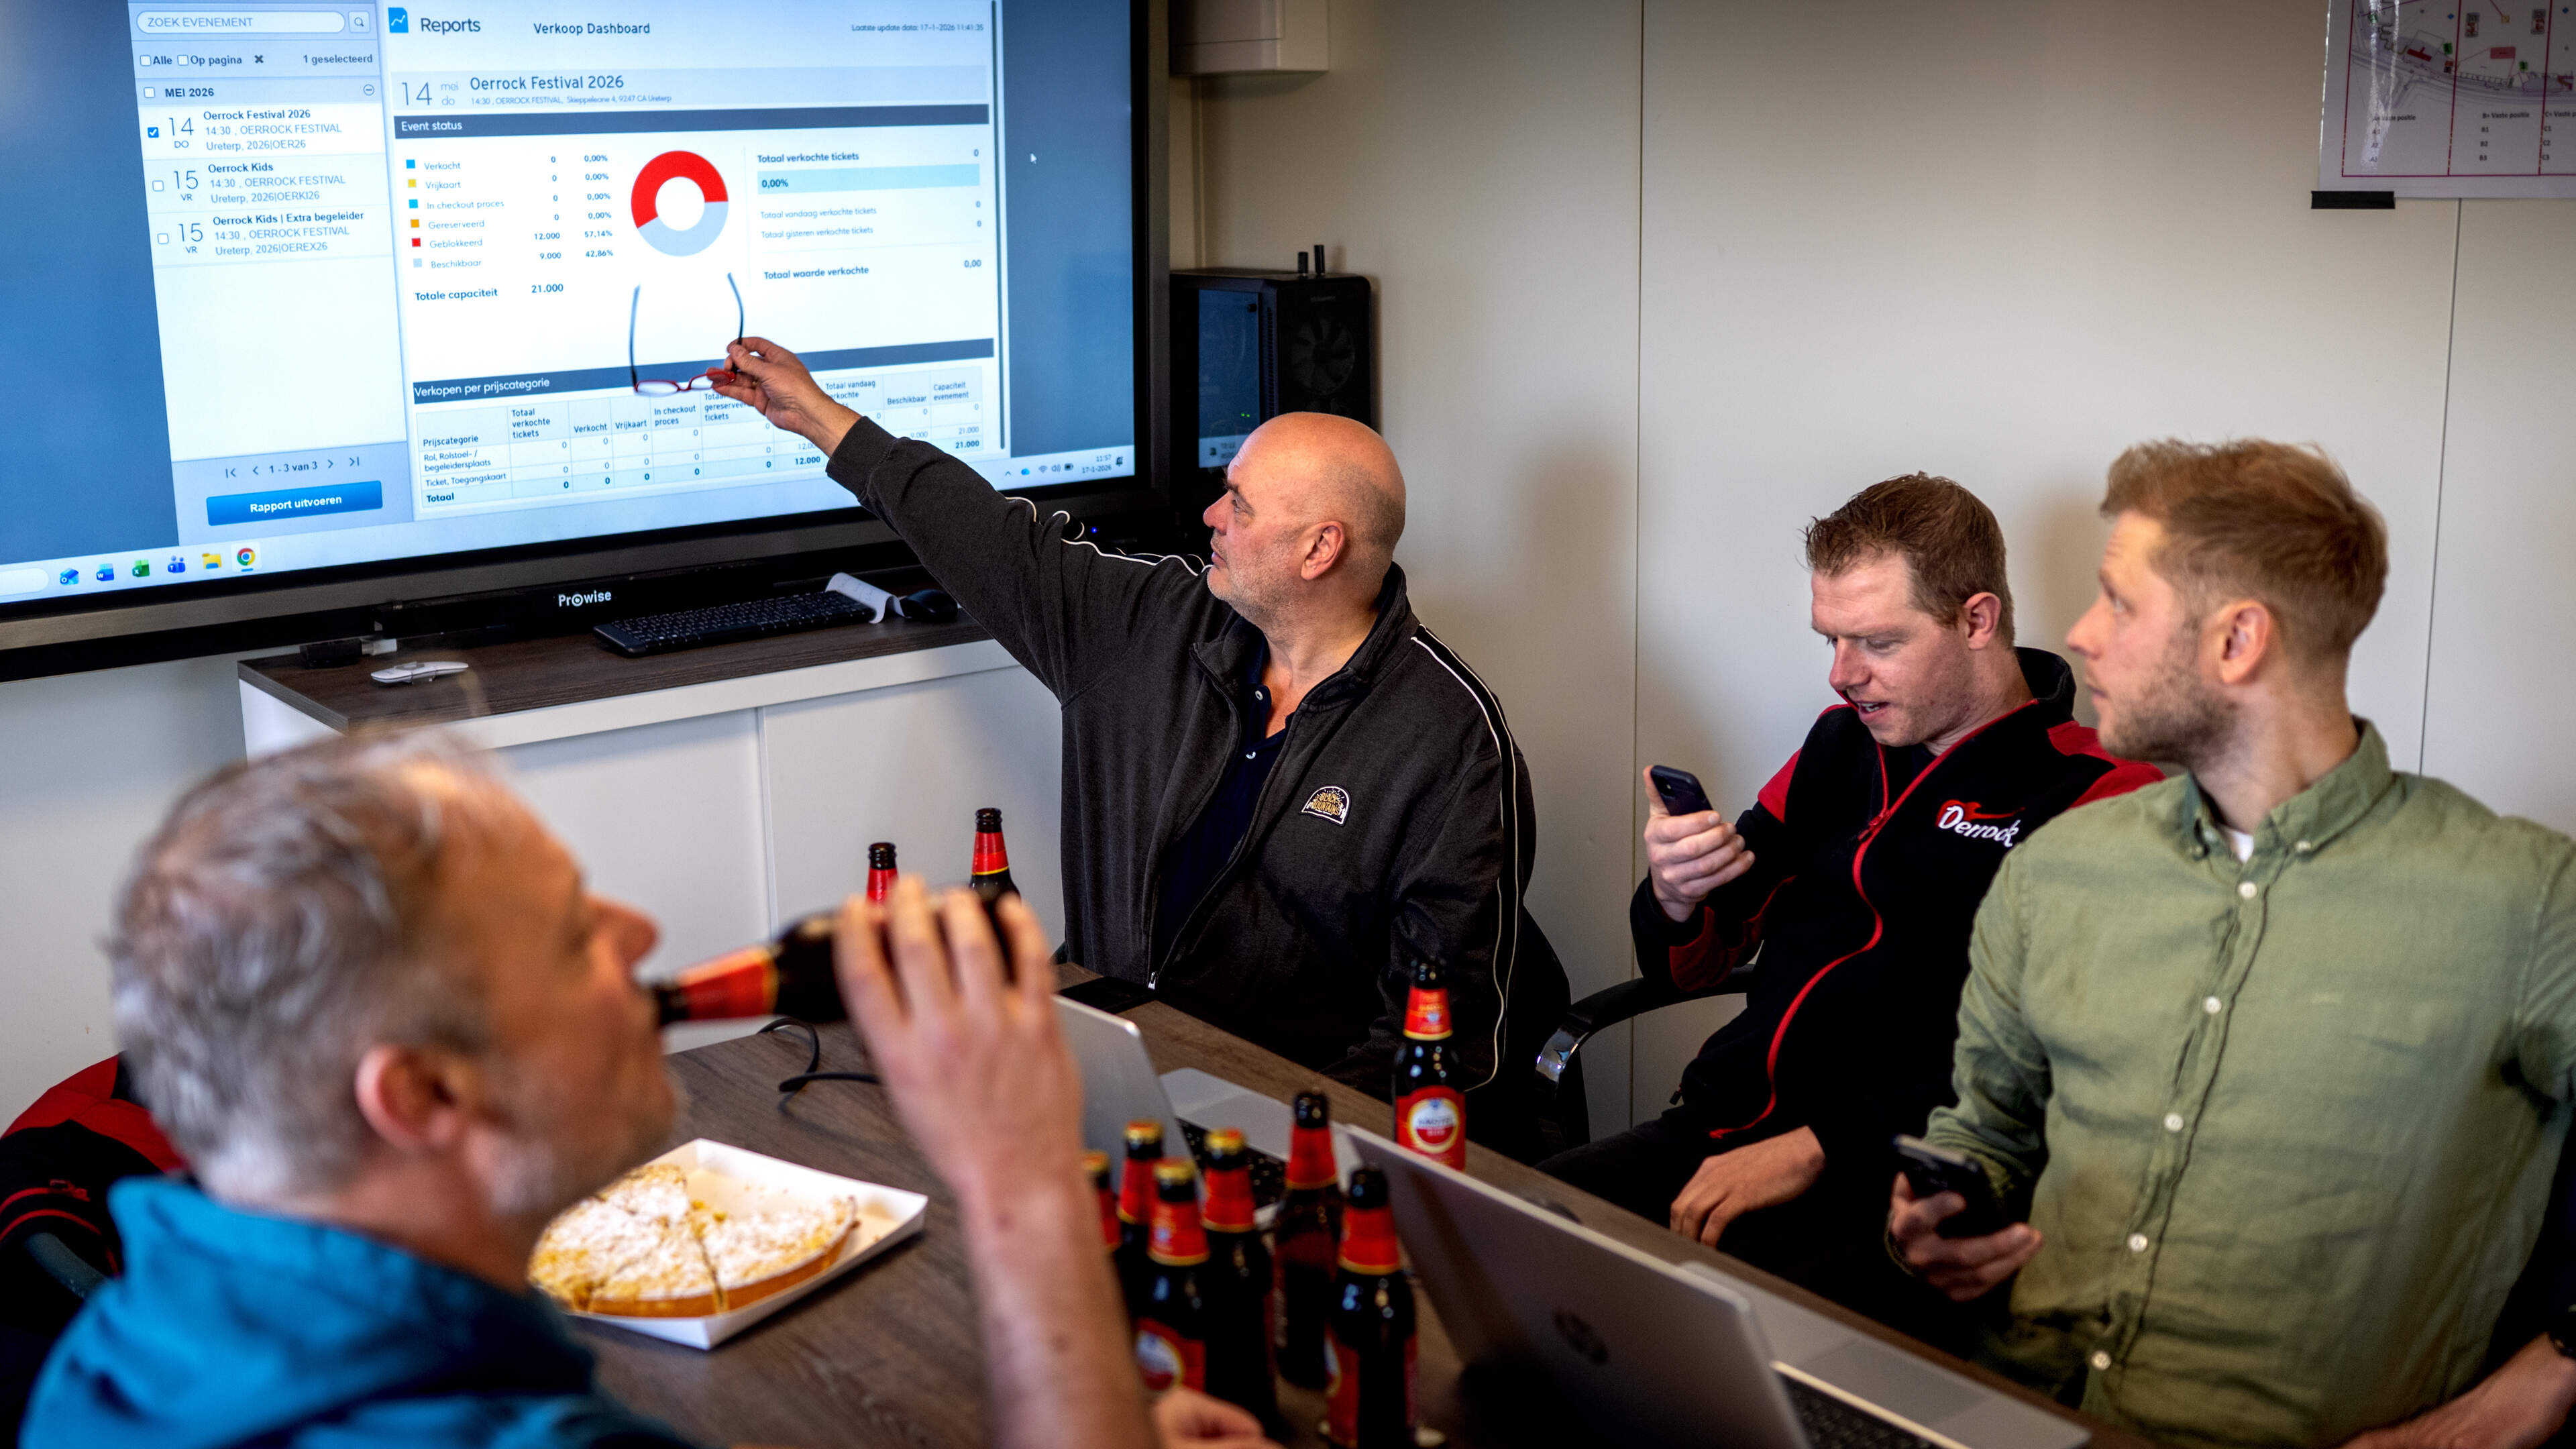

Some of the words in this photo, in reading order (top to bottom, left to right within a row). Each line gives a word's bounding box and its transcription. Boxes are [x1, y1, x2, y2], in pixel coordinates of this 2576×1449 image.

[148, 17, 179, 27] ZOEK
[183, 17, 254, 27] EVENEMENT
[421, 18, 481, 35] Reports
[534, 23, 583, 36] Verkoop
[588, 23, 650, 34] Dashboard
[877, 24, 900, 33] update
[153, 56, 172, 64] Alle
[191, 55, 206, 66] Op
[209, 55, 242, 66] pagina
[303, 55, 308, 63] 1
[312, 54, 373, 65] geselecteerd
[441, 81, 459, 91] mei
[470, 76, 527, 91] Oerrock
[531, 76, 584, 89] Festival
[588, 75, 625, 89] 2026
[165, 88, 186, 98] MEI
[189, 88, 215, 97] 2026
[402, 82, 433, 106] 14
[441, 96, 455, 106] do
[496, 97, 531, 105] OERROCK
[649, 95, 672, 103] Ureterp
[203, 111, 244, 121] Oerrock
[248, 110, 285, 119] Festival
[288, 109, 311, 119] 2026
[168, 117, 194, 136] 14
[206, 126, 231, 135] 14:30
[240, 125, 292, 135] OERROCK
[295, 124, 342, 133] FESTIVAL
[402, 121, 429, 131] Event
[432, 121, 462, 130] status
[174, 140, 189, 148] DO
[584, 154, 608, 162] 0,00%
[757, 154, 785, 163] Totaal
[786, 153, 829, 162] verkochte
[831, 152, 859, 161] tickets
[209, 163, 249, 173] Oerrock
[252, 162, 274, 172] Kids
[424, 161, 461, 170] Verkocht
[174, 170, 199, 190] 15
[211, 179, 235, 189] 14:30
[245, 177, 297, 187] OERROCK
[299, 175, 345, 185] FESTIVAL
[585, 173, 609, 181] 0,00%
[425, 180, 461, 191] Vrijkaart
[761, 179, 788, 189] 0,00%
[180, 193, 193, 201] VR
[587, 193, 610, 201] 0,00%
[437, 200, 474, 209] checkout
[477, 200, 504, 210] proces
[213, 215, 253, 226] Oerrock
[256, 215, 278, 225] Kids
[286, 213, 312, 223] Extra
[315, 211, 364, 223] begeleider
[761, 210, 784, 219] Totaal
[785, 209, 818, 220] vandaag
[819, 207, 853, 217] verkochte
[855, 207, 877, 215] tickets
[429, 220, 485, 230] Gereserveerd
[178, 223, 203, 242] 15
[215, 231, 240, 240] 14:30
[250, 229, 301, 239] OERROCK
[303, 227, 350, 237] FESTIVAL
[535, 232, 560, 240] 12.000
[585, 230, 612, 238] 57,14%
[762, 230, 784, 239] Totaal
[786, 228, 814, 239] gisteren
[816, 227, 850, 237] verkochte
[851, 226, 873, 235] tickets
[430, 238, 482, 249] Geblokkeerd
[186, 246, 197, 254] VR
[540, 252, 561, 260] 9.000
[586, 249, 613, 258] 42,86%
[431, 258, 482, 269] Beschikbaar
[964, 259, 981, 268] 0,00
[764, 270, 791, 280] Totaal
[793, 268, 825, 278] waarde
[828, 266, 869, 276] verkochte
[531, 283, 564, 293] 21.000
[415, 291, 445, 301] Totale
[448, 288, 498, 301] capaciteit
[415, 384, 462, 398] Verkopen
[465, 384, 481, 394] per
[484, 377, 550, 392] prijscategorie
[826, 382, 846, 390] Totaal
[848, 380, 875, 388] vandaag
[934, 382, 966, 391] Capaciteit
[888, 395, 926, 406] Beschikbaar
[934, 391, 969, 401] evenement
[513, 408, 535, 417] Totaal
[663, 405, 696, 415] checkout
[655, 417, 679, 427] proces
[705, 413, 729, 421] tickets
[513, 418, 550, 428] verkochte
[574, 422, 607, 433] Verkocht
[615, 419, 647, 430] Vrijkaart
[513, 429, 539, 439] tickets
[959, 427, 979, 435] 21.000
[423, 434, 478, 447] Prijscategorie
[424, 453, 437, 462] Rol,
[439, 450, 472, 460] Rolstoel-
[796, 456, 820, 466] 12.000
[955, 440, 980, 449] 21.000
[284, 464, 289, 472] 3
[292, 463, 309, 471] van
[312, 461, 318, 470] 3
[425, 459, 491, 472] begeleidersplaats
[426, 478, 450, 488] Ticket,
[451, 473, 506, 485] Toegangskaart
[427, 492, 454, 502] Totaal
[250, 500, 292, 514] Rapport
[294, 495, 342, 508] uitvoeren
[558, 590, 612, 607] Prowise
